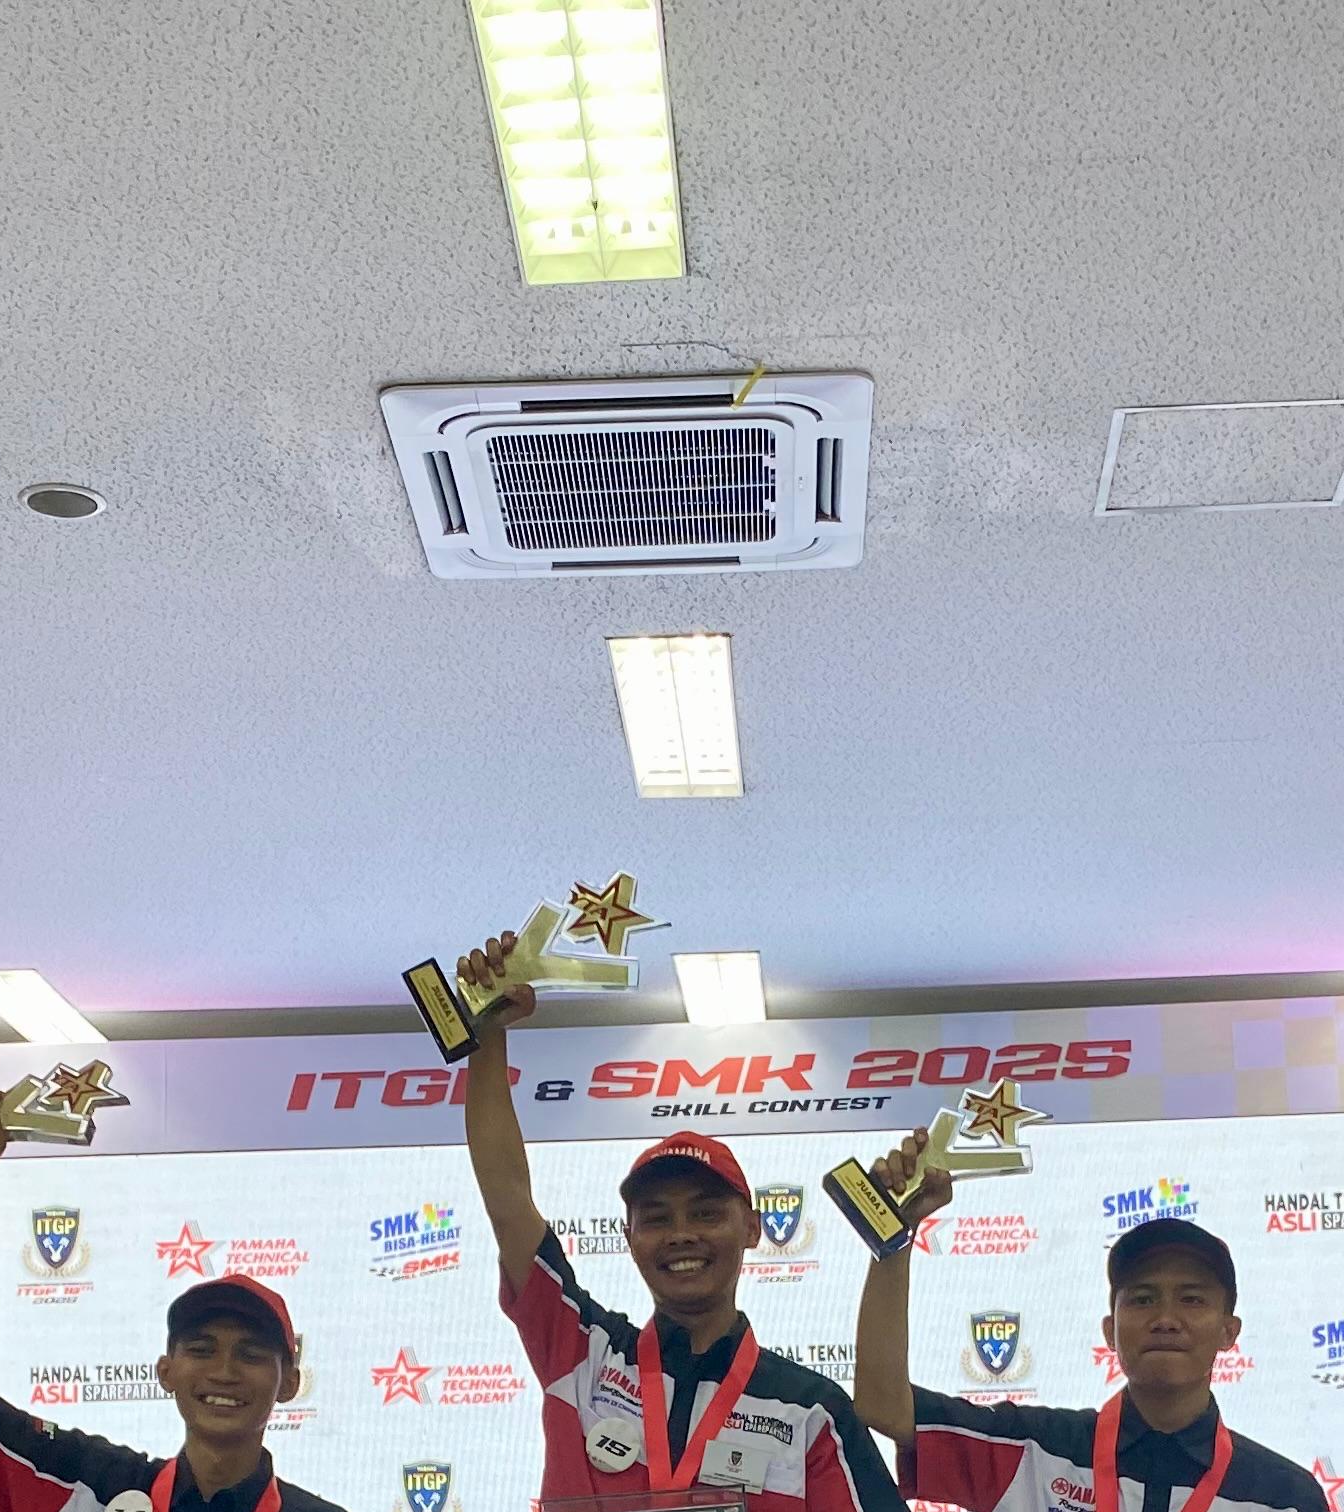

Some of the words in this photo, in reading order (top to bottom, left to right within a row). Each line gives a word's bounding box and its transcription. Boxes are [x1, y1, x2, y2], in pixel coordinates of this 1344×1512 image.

[535, 1080, 574, 1101] &
[587, 1053, 816, 1098] SMK
[846, 1040, 1132, 1088] 2025
[651, 1100, 736, 1117] SKILL
[748, 1096, 891, 1113] CONTEST
[855, 1178, 882, 1211] JUARA
[1102, 1186, 1154, 1218] SMK
[1264, 1194, 1329, 1213] HANDAL
[758, 1195, 800, 1214] ITGP
[36, 1217, 76, 1235] ITGP
[369, 1211, 420, 1241] SMK
[957, 1215, 1025, 1228] YAMAHA
[1266, 1213, 1317, 1233] ASLI
[229, 1238, 297, 1250] YAMAHA
[383, 1226, 463, 1253] BISA-HEBAT
[953, 1229, 1040, 1241] TECHNICAL
[950, 1242, 1029, 1255] ACADEMY
[225, 1252, 311, 1265] TECHNICAL
[401, 1252, 460, 1274] SMK
[224, 1265, 300, 1277] ACADEMY
[975, 1321, 1017, 1341] ITGP
[30, 1365, 90, 1384] HANDAL
[446, 1363, 513, 1376] YAMAHA
[442, 1376, 527, 1390] TECHNICAL
[30, 1385, 78, 1404] ASLI
[440, 1391, 516, 1405] ACADEMY
[595, 1434, 632, 1458] 15
[407, 1473, 448, 1491] ITGP
